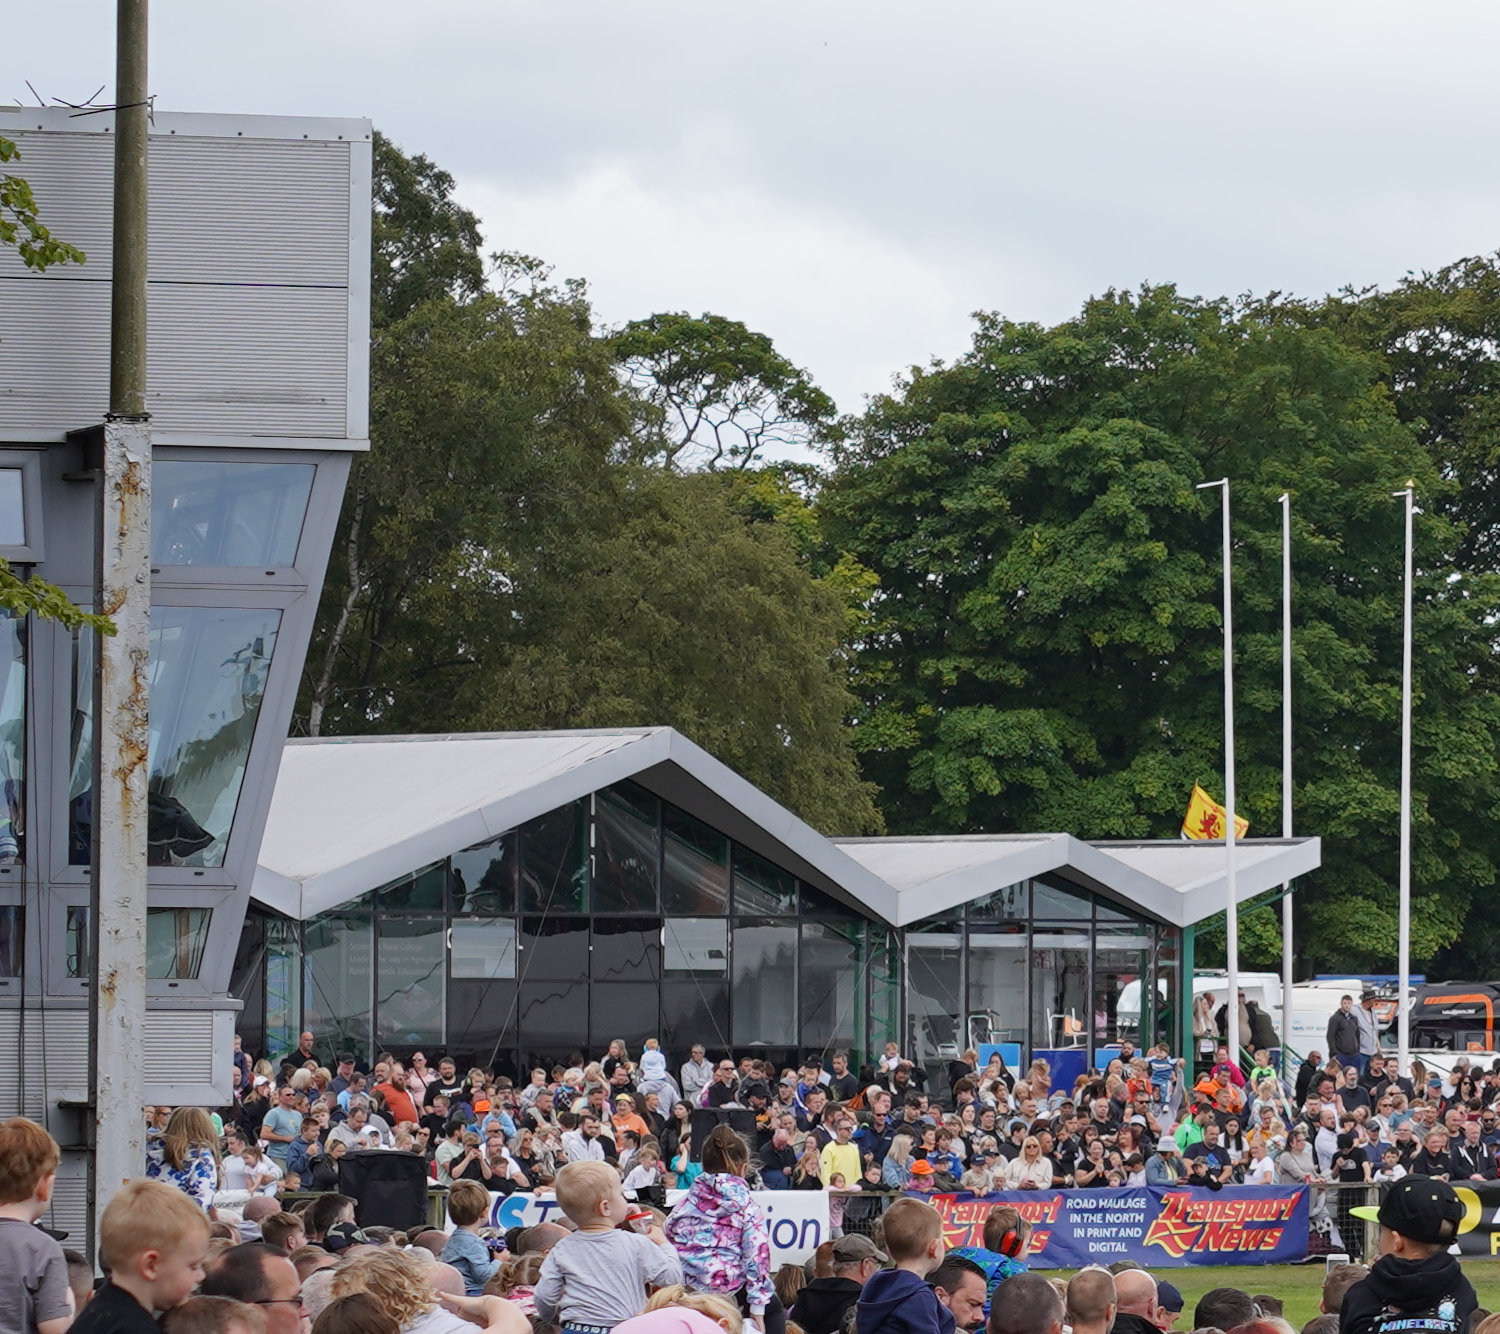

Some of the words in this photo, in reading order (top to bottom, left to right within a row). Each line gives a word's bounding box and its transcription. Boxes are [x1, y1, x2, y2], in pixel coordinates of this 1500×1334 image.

[928, 1193, 1064, 1224] Tranport
[1066, 1198, 1096, 1209] ROAD
[1098, 1198, 1147, 1209] HAULAGE
[1160, 1192, 1302, 1223] Transport
[1069, 1213, 1080, 1223] IN
[1082, 1213, 1103, 1223] THE
[1105, 1213, 1144, 1223] NORTH
[1073, 1228, 1084, 1238] IN
[1086, 1228, 1117, 1238] PRINT
[1118, 1227, 1142, 1238] AND
[1193, 1223, 1285, 1252] News
[1088, 1242, 1128, 1252] DIGITAL
[1379, 1318, 1456, 1333] MINECRAFT
